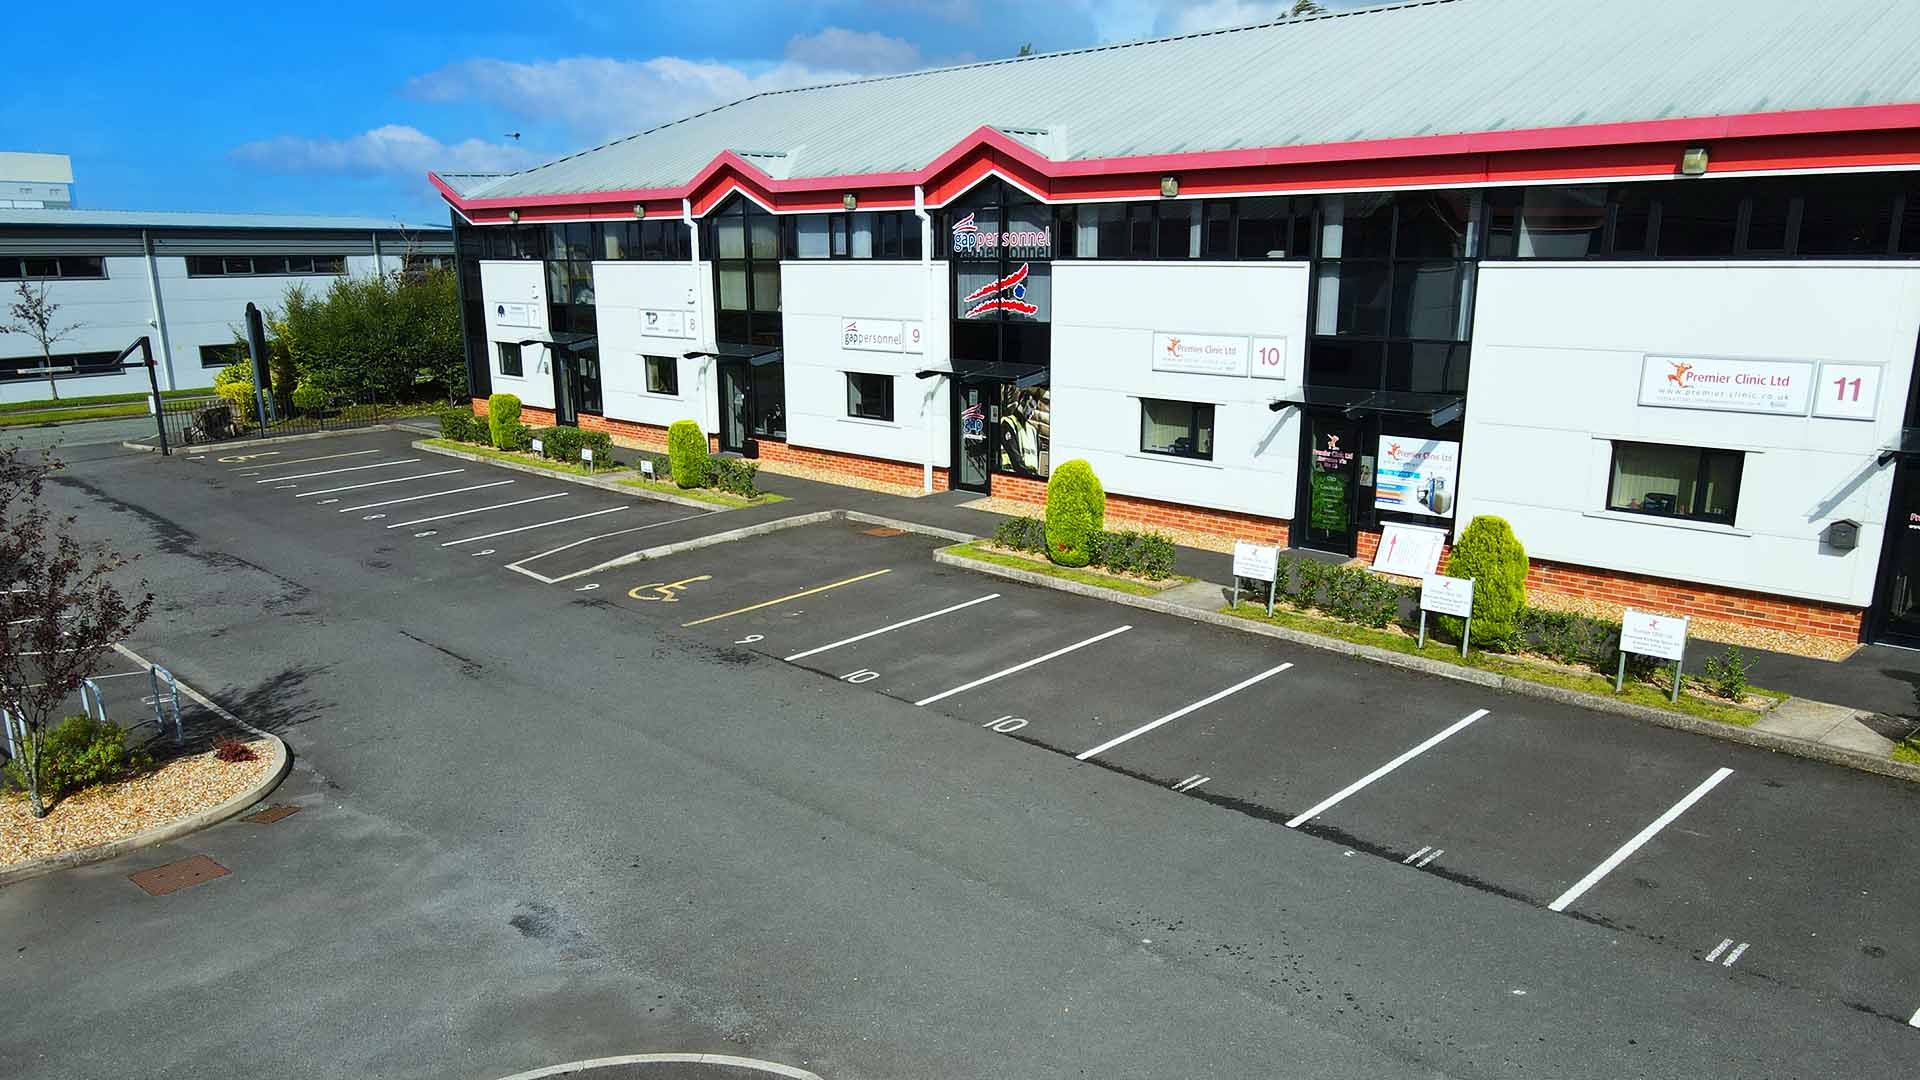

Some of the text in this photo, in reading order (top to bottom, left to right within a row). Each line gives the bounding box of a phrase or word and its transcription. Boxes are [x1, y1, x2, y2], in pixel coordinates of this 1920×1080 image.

[690, 319, 695, 330] 8
[912, 328, 920, 343] 9
[1259, 347, 1280, 366] 10
[1686, 371, 1790, 387] Premier Clinic Ltd
[1833, 376, 1862, 402] 11
[575, 583, 600, 591] 9
[734, 634, 765, 644] 9
[839, 668, 880, 683] 10
[981, 715, 1029, 733] 10
[1171, 774, 1211, 792] 11
[1402, 846, 1445, 868] 11
